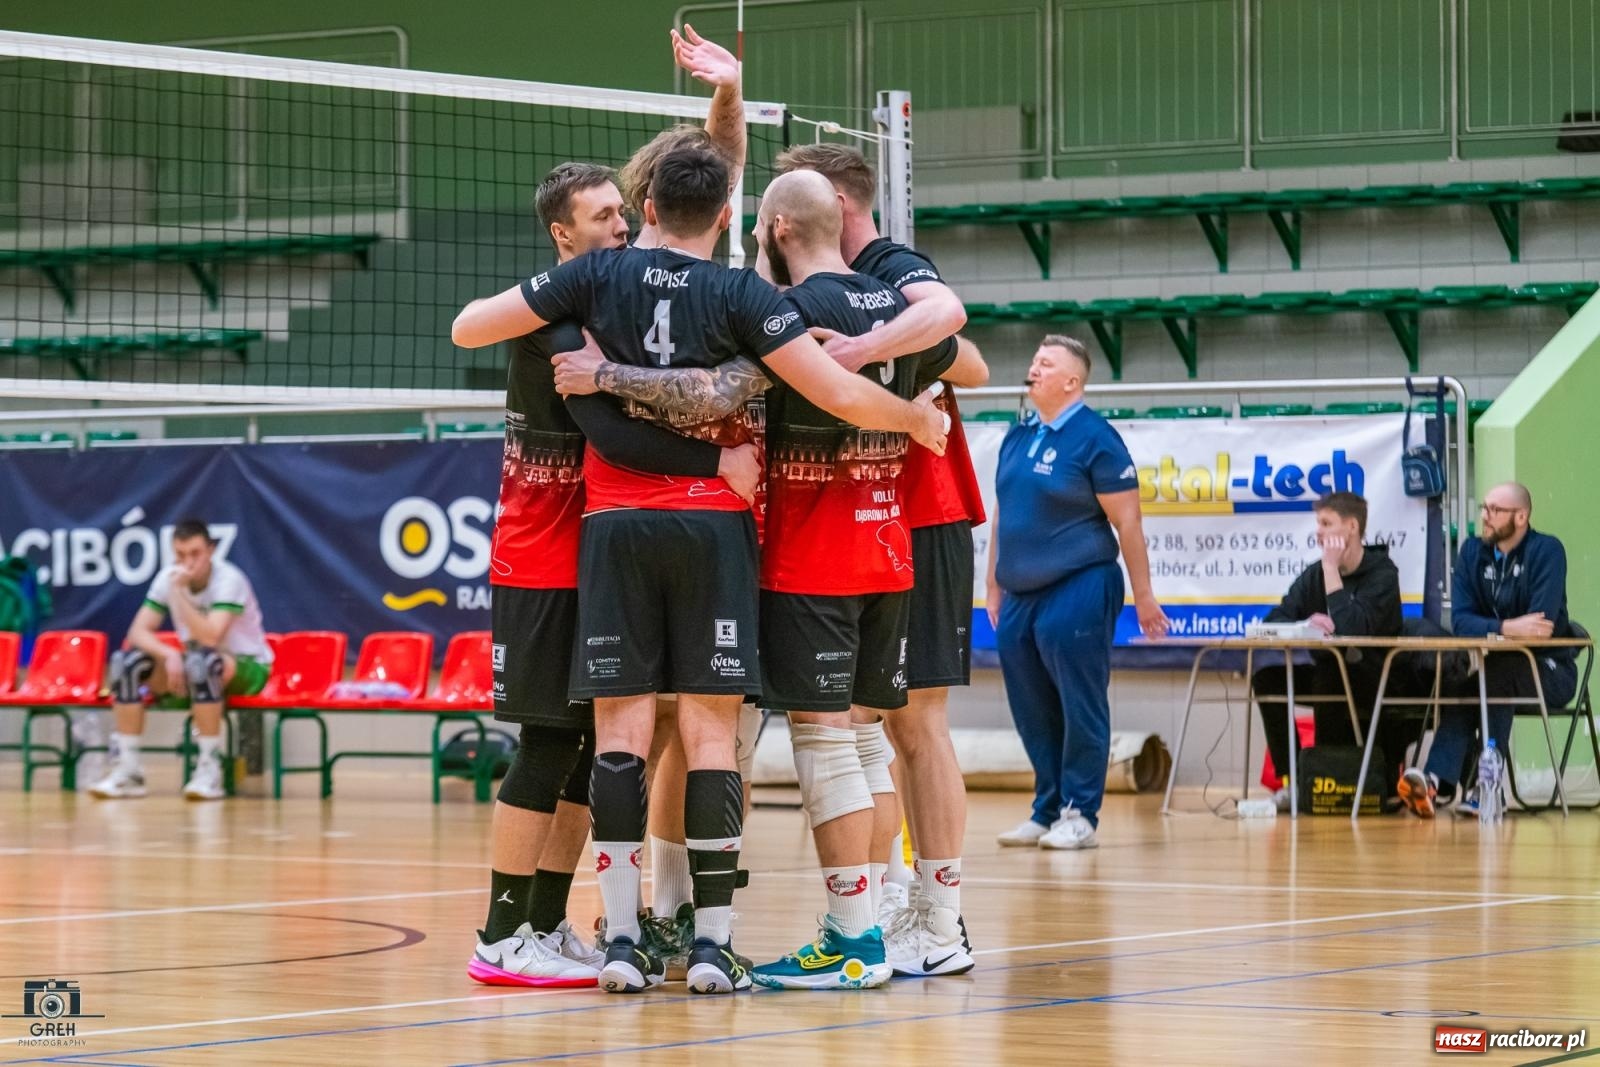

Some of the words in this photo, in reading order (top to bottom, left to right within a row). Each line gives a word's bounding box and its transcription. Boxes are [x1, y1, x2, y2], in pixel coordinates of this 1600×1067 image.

[643, 267, 690, 288] KOPISZ
[643, 299, 676, 366] 4
[1138, 449, 1365, 502] stal-tech
[0, 505, 238, 587] CIBÓZ
[380, 495, 500, 579] OS
[1196, 535, 1224, 552] 502
[1230, 533, 1258, 551] 632
[1243, 562, 1273, 577] von
[456, 585, 492, 610] RA
[713, 656, 741, 668] NEMO
[1313, 777, 1336, 794] 3D
